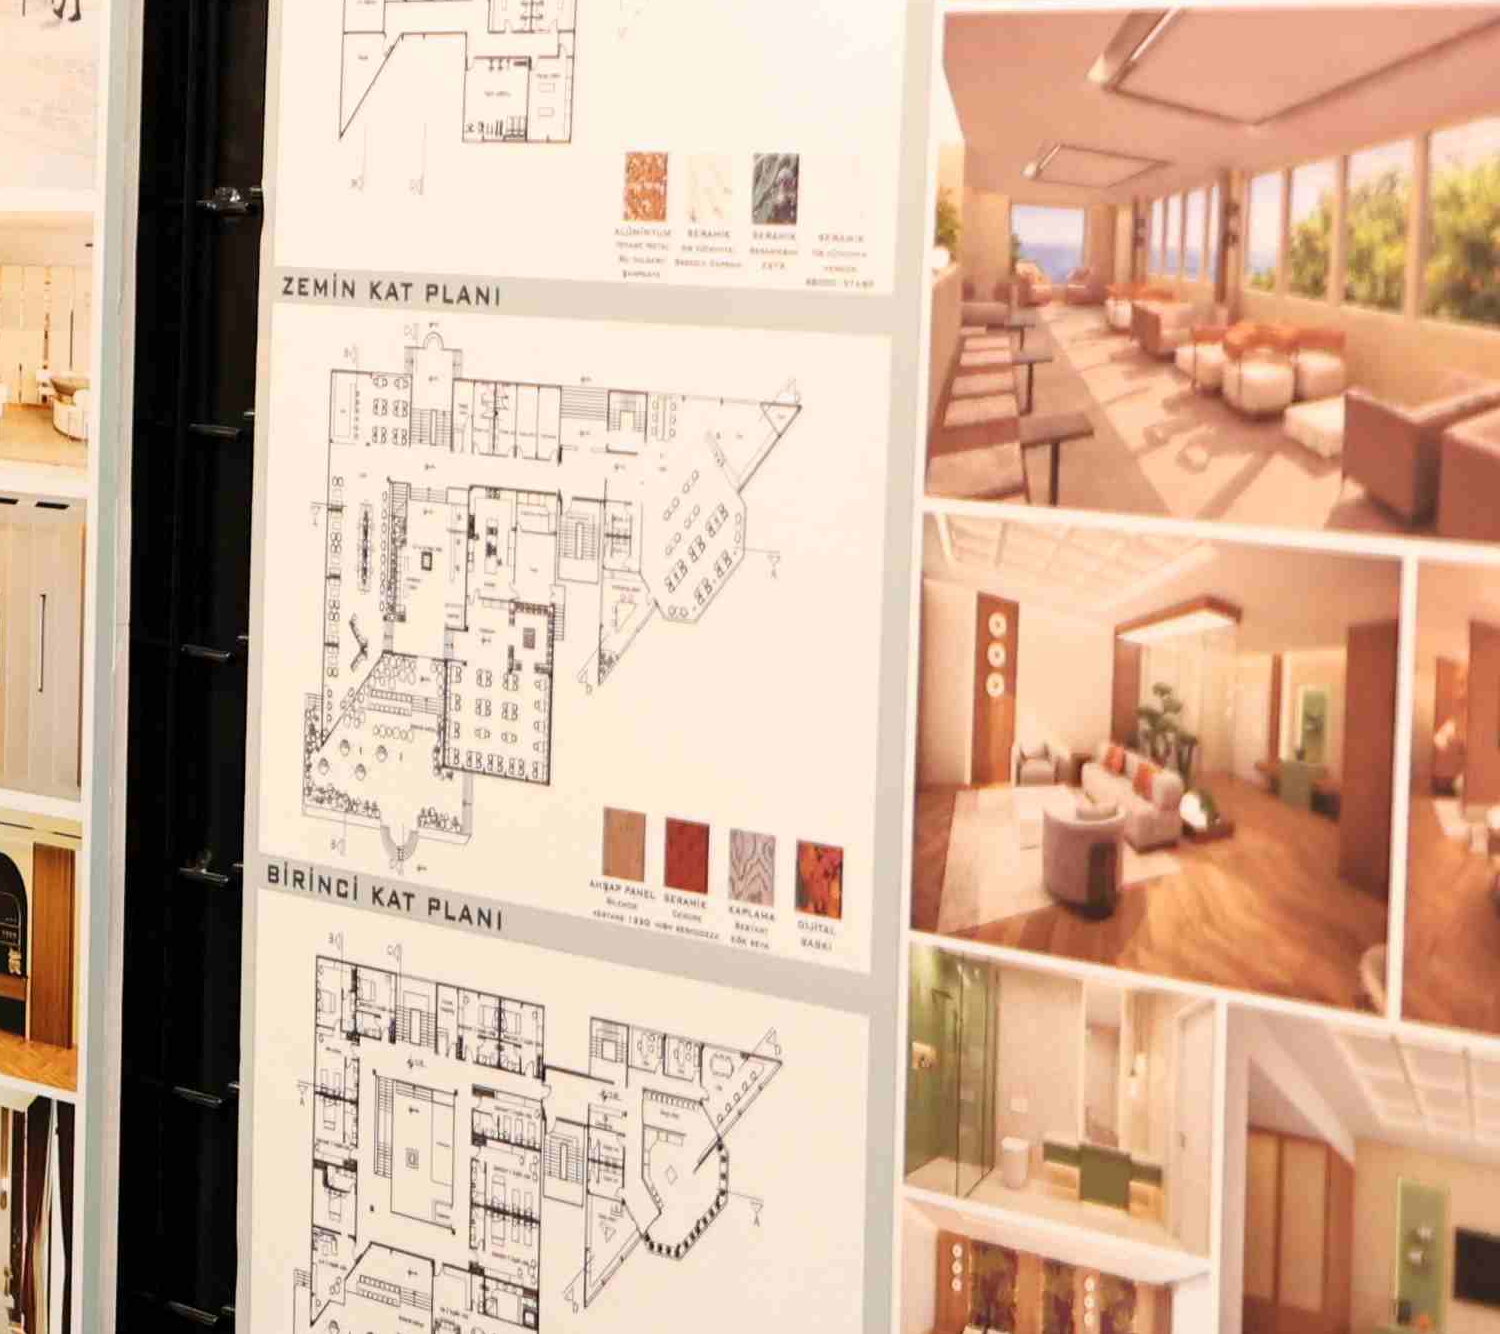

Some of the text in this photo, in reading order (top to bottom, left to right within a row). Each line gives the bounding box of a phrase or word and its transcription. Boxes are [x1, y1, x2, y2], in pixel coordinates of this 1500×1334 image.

[282, 274, 502, 307] ZEMİN KAT PLANI
[266, 863, 503, 932] BİRİNCİ KAT PLANI
